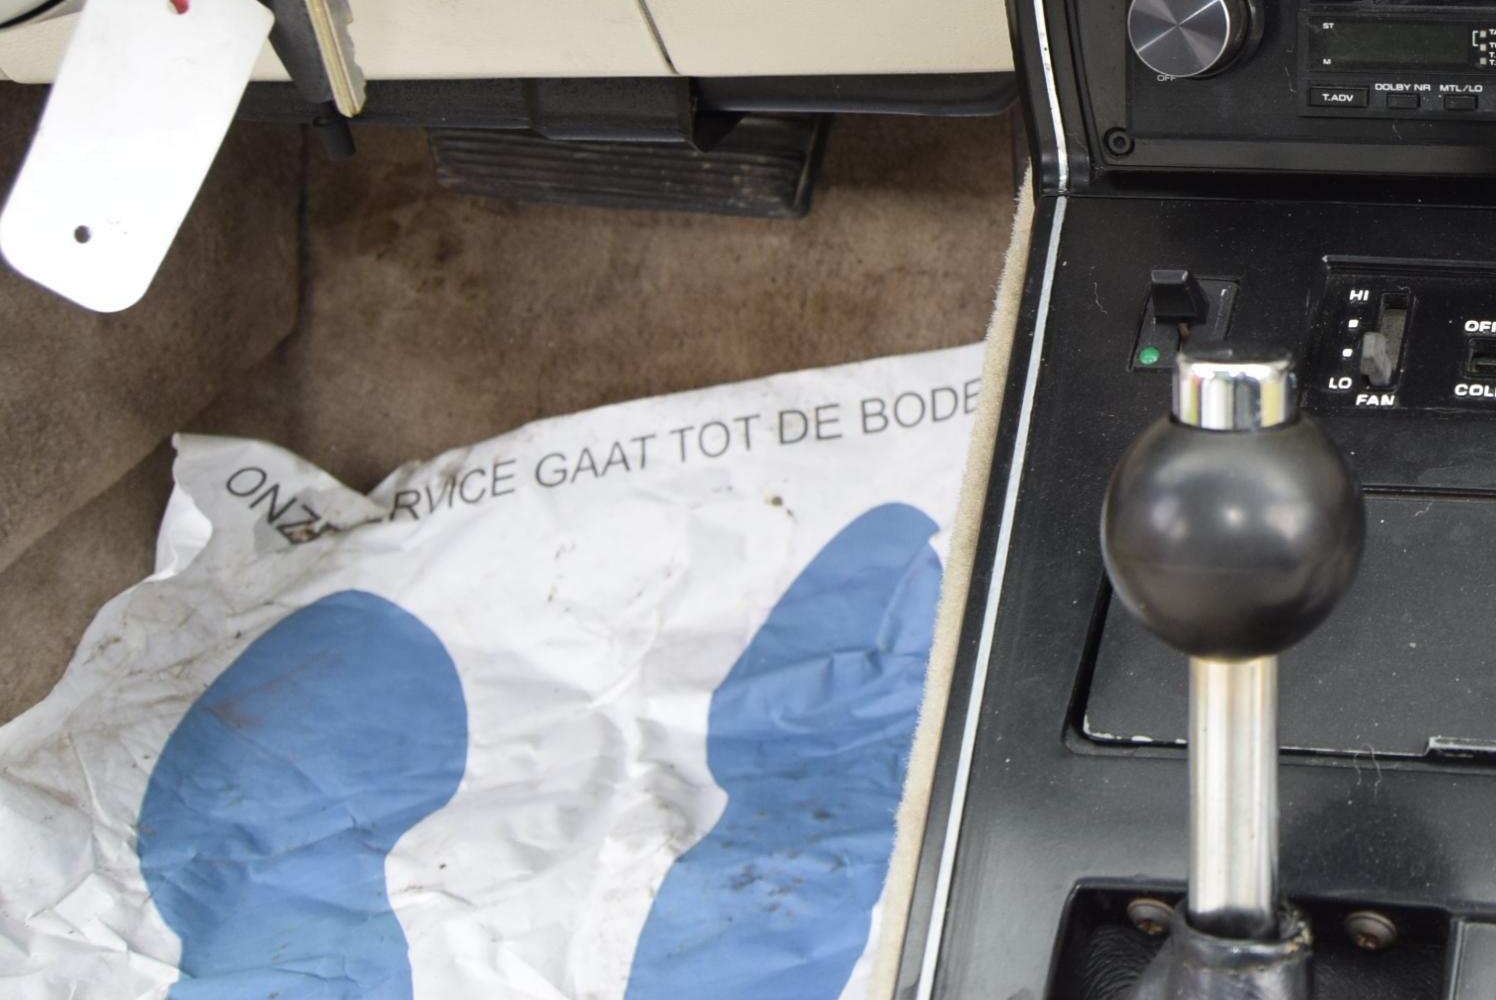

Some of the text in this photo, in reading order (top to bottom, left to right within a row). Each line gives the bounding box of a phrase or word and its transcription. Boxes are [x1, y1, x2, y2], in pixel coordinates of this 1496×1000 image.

[1375, 83, 1431, 91] DOLBY NR
[1440, 84, 1483, 92] MTL/LO
[1322, 93, 1354, 102] T.ADV
[1350, 290, 1369, 301] HI
[1329, 377, 1352, 390] LO
[1356, 394, 1395, 406] FAN
[226, 466, 341, 545] ONZ
[368, 459, 516, 523] RVICE
[534, 434, 656, 488] GAAT
[670, 414, 760, 462] TOT
[778, 404, 843, 445] DE
